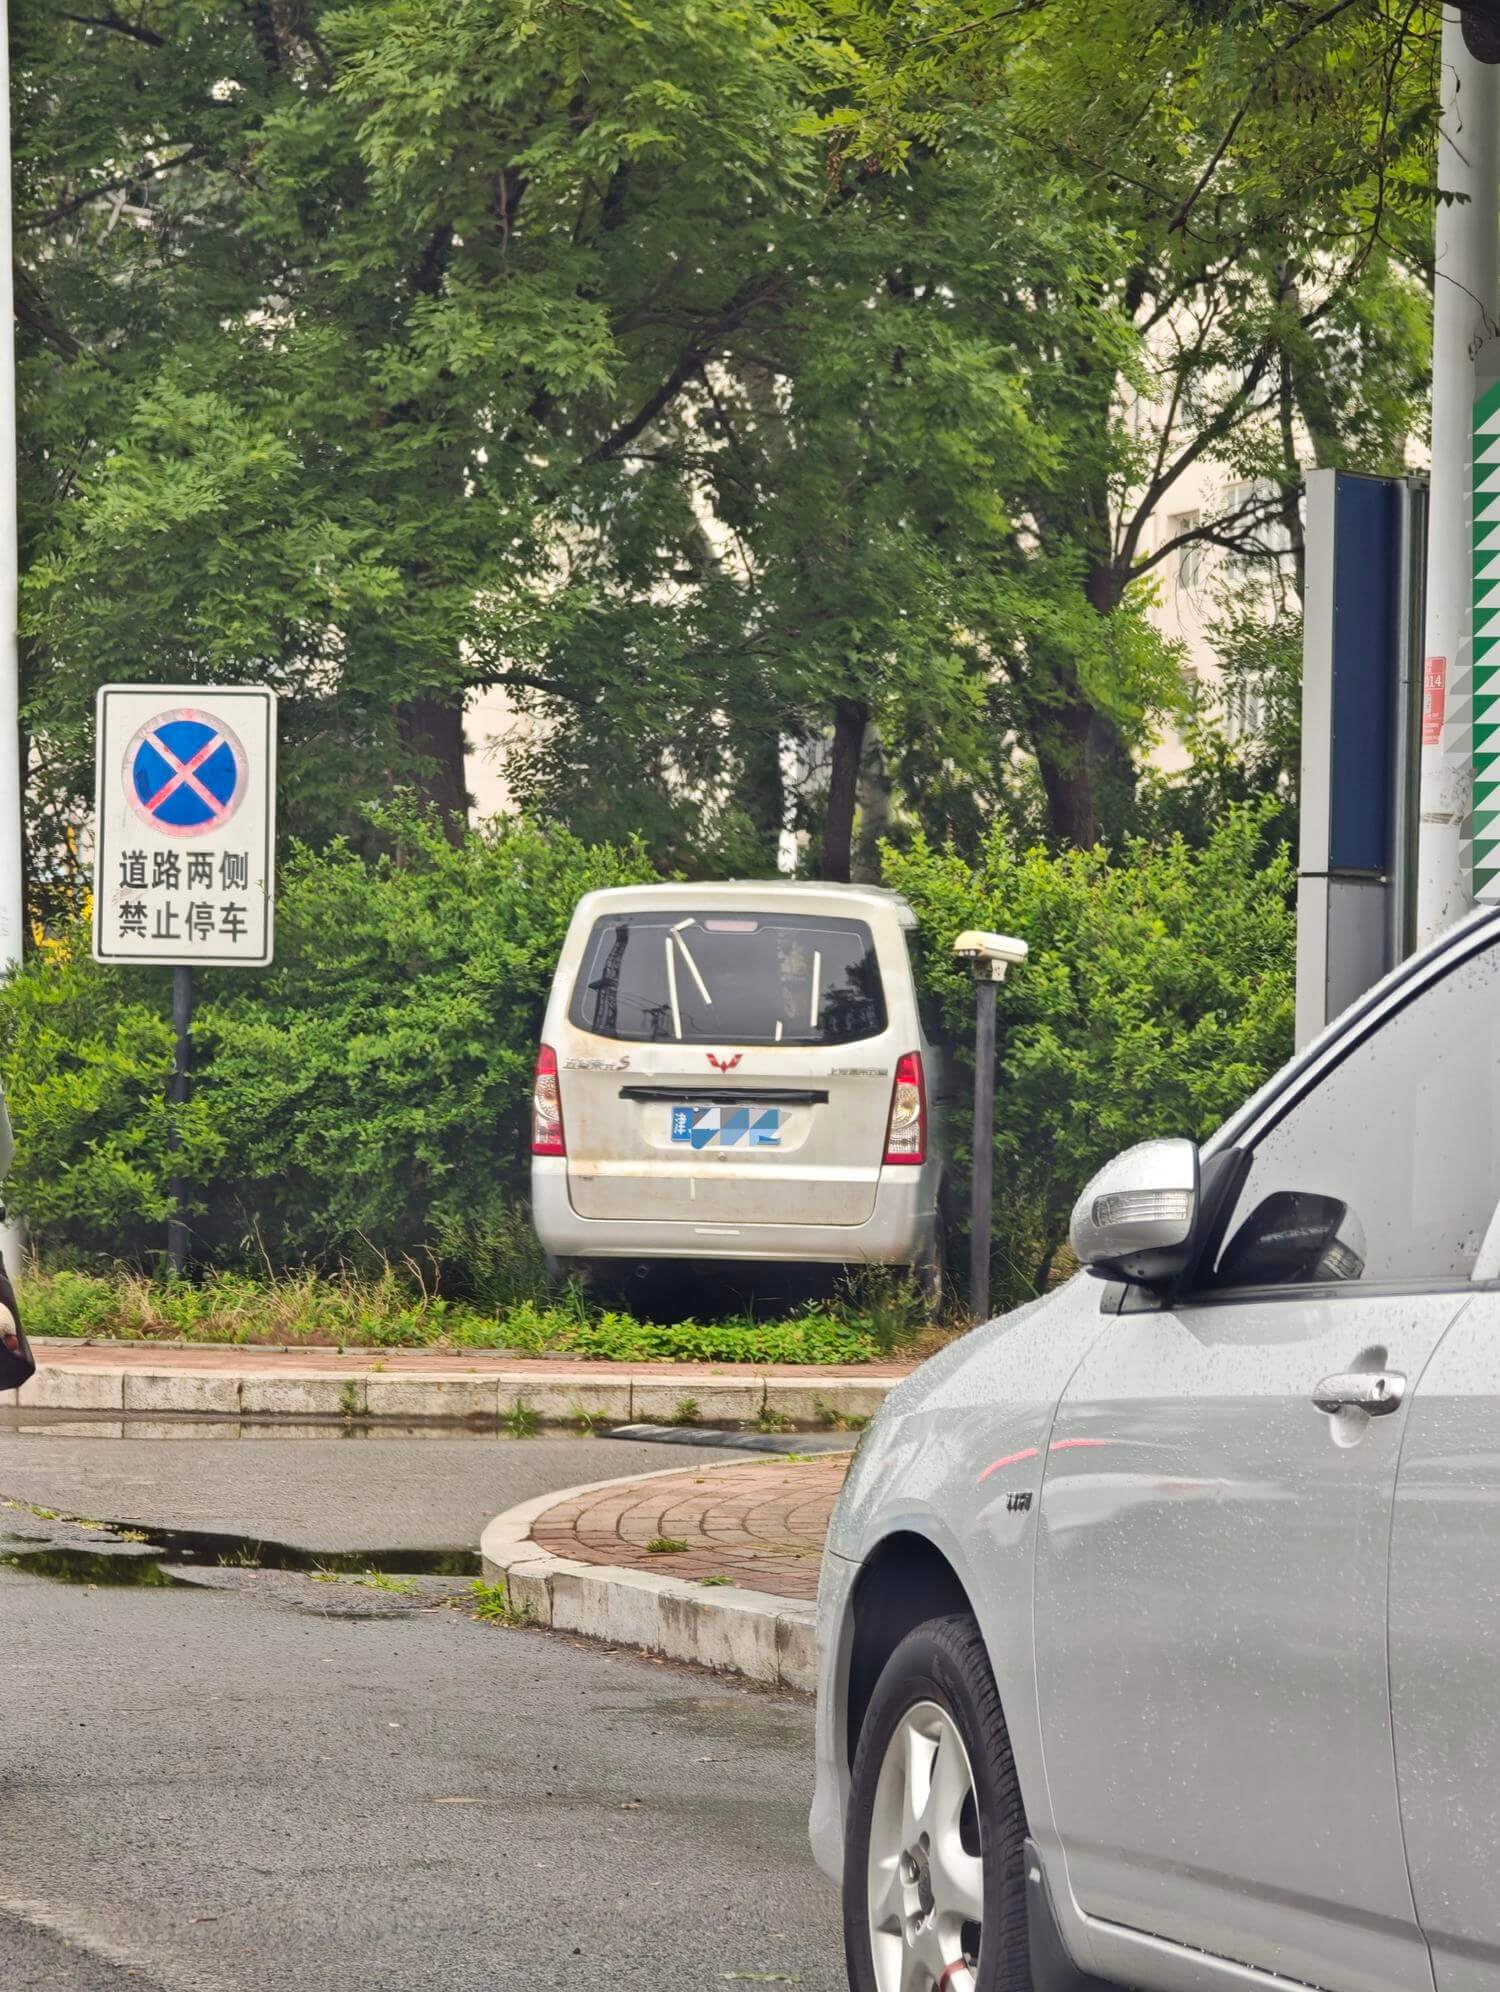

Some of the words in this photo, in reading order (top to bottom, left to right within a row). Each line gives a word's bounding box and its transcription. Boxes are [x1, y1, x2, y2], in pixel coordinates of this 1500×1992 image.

[119, 850, 248, 891] 道路两侧
[119, 901, 248, 942] 禁止停车
